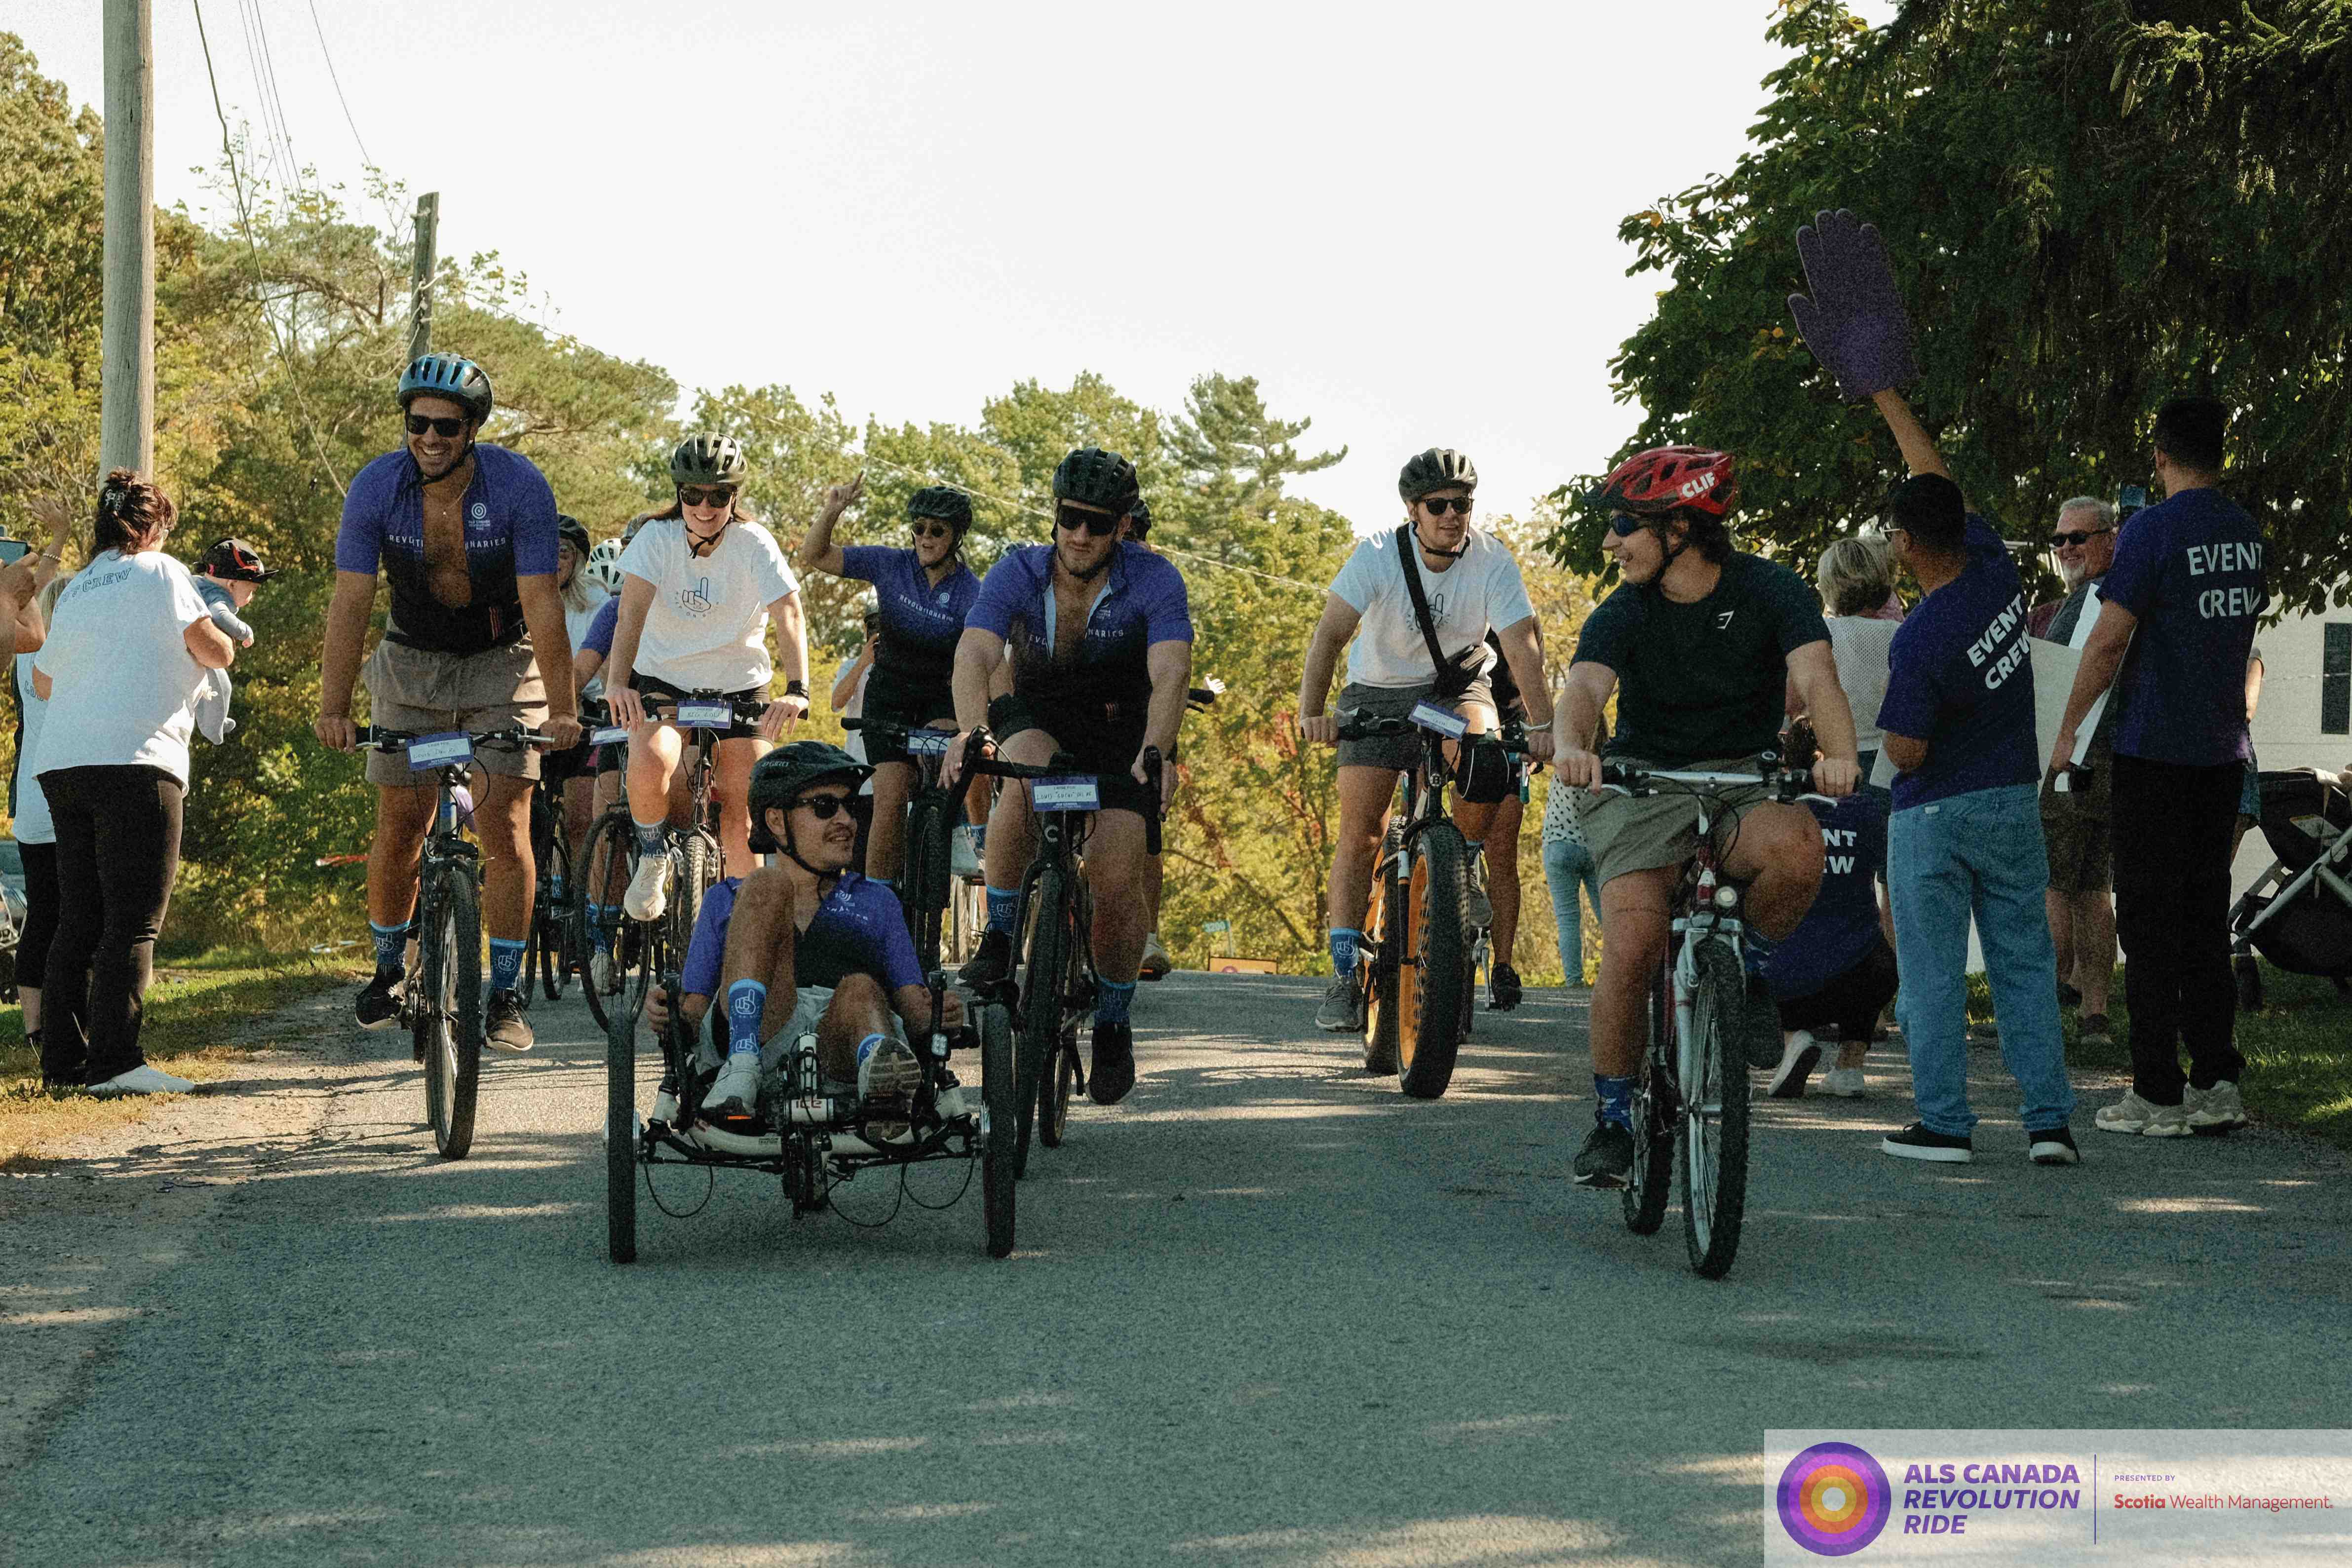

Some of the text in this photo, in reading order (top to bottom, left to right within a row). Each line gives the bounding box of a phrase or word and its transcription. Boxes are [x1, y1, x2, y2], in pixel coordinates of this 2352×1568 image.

[1682, 471, 1715, 497] CLIF
[2187, 542, 2263, 576] EVENT
[82, 568, 132, 593] CREW
[1966, 593, 2023, 667] EVENT
